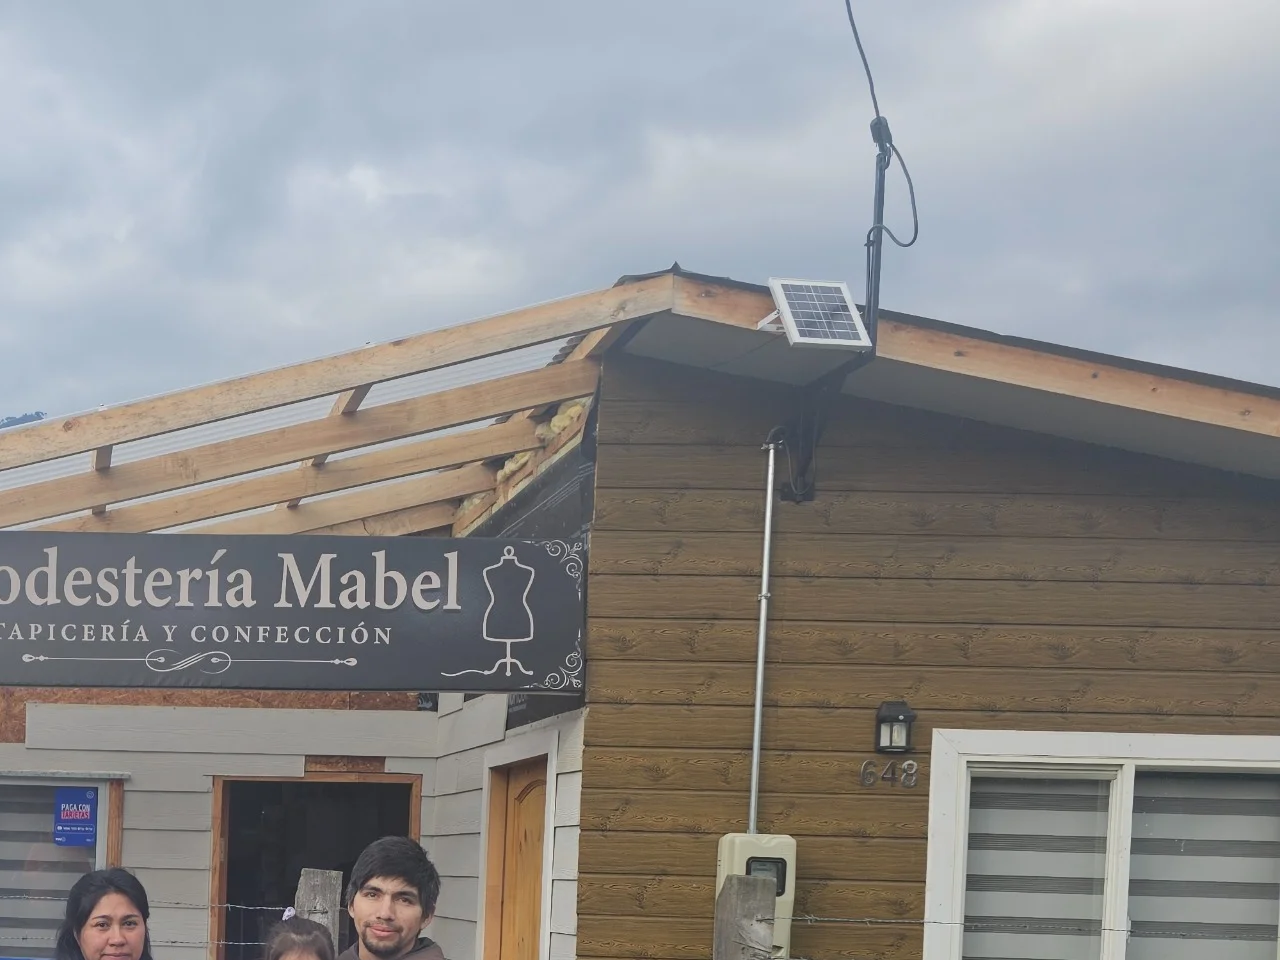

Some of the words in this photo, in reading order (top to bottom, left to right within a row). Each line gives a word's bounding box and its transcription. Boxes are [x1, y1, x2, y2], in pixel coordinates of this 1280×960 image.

[274, 550, 462, 610] Mabel
[162, 625, 178, 642] Y
[190, 621, 392, 645] CONFECCIÓN
[860, 759, 918, 788] 648
[61, 803, 77, 812] PAGA
[78, 803, 91, 812] CON
